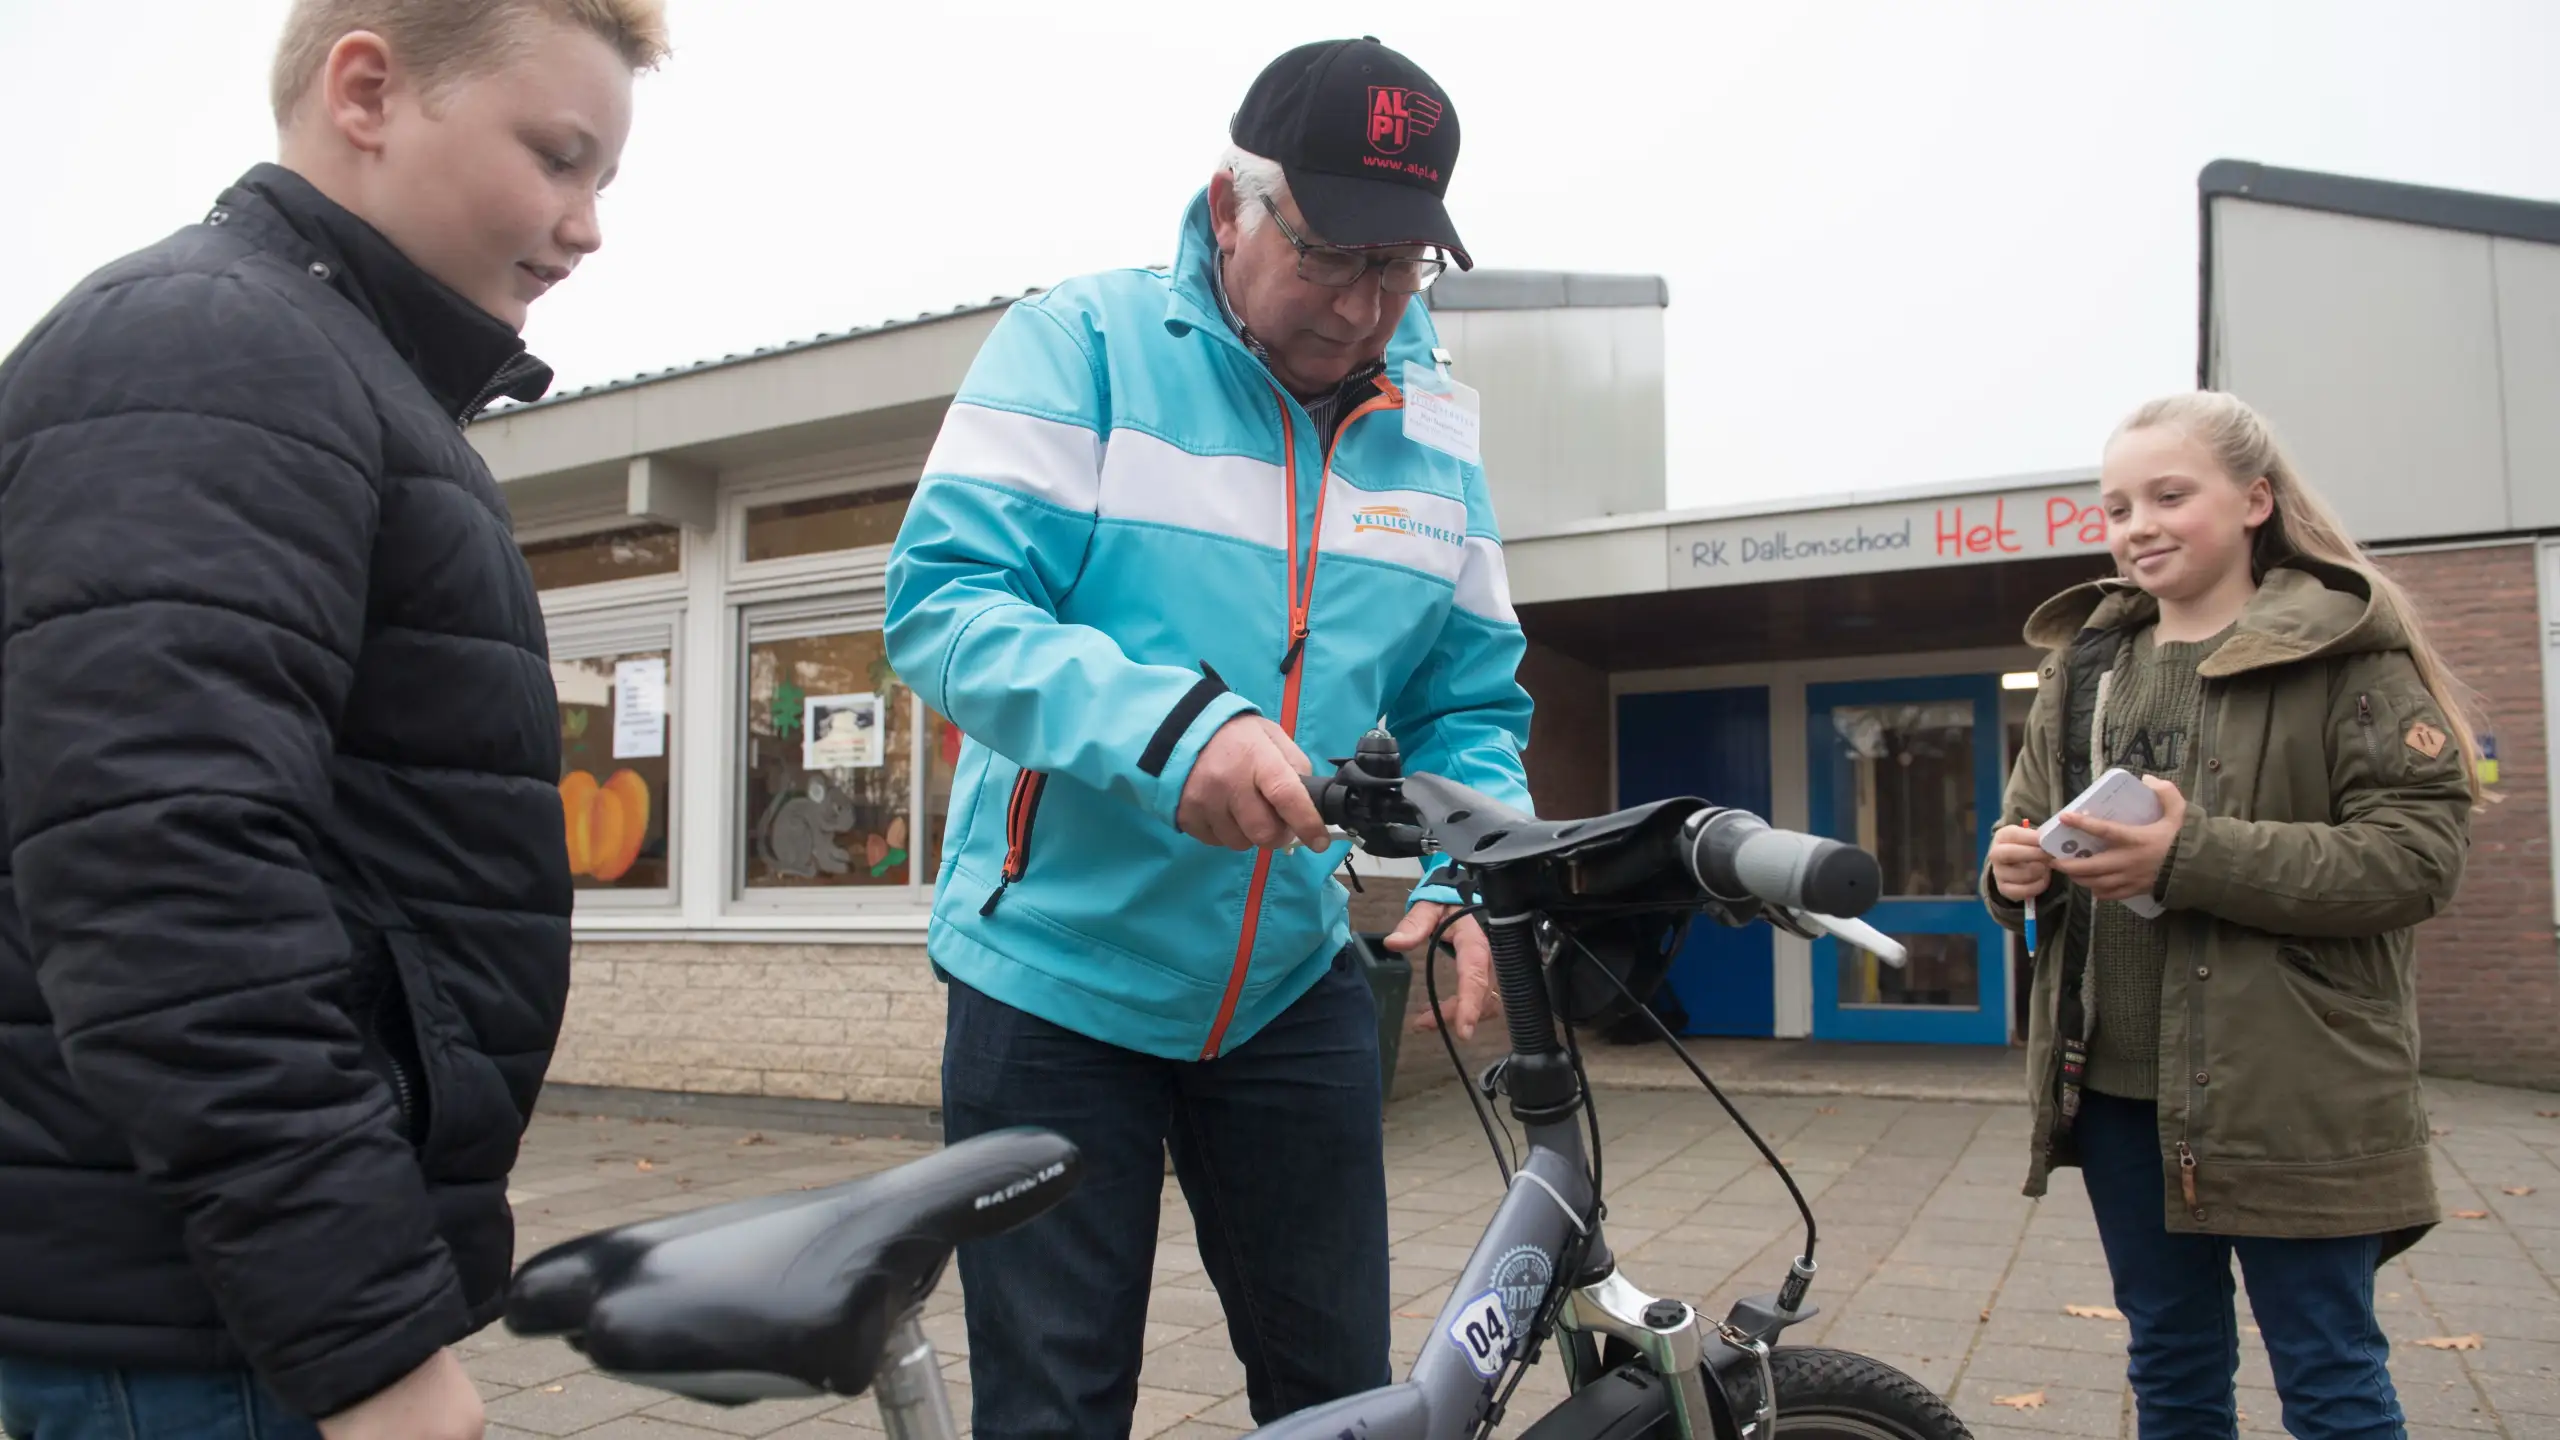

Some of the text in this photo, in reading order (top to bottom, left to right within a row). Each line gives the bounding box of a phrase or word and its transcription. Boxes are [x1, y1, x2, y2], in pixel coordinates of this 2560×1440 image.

[1372, 90, 1409, 117] AL
[1371, 115, 1404, 145] PI
[1692, 495, 2107, 568] RK Daltonschool Het Pa
[1466, 1305, 1505, 1359] 04
